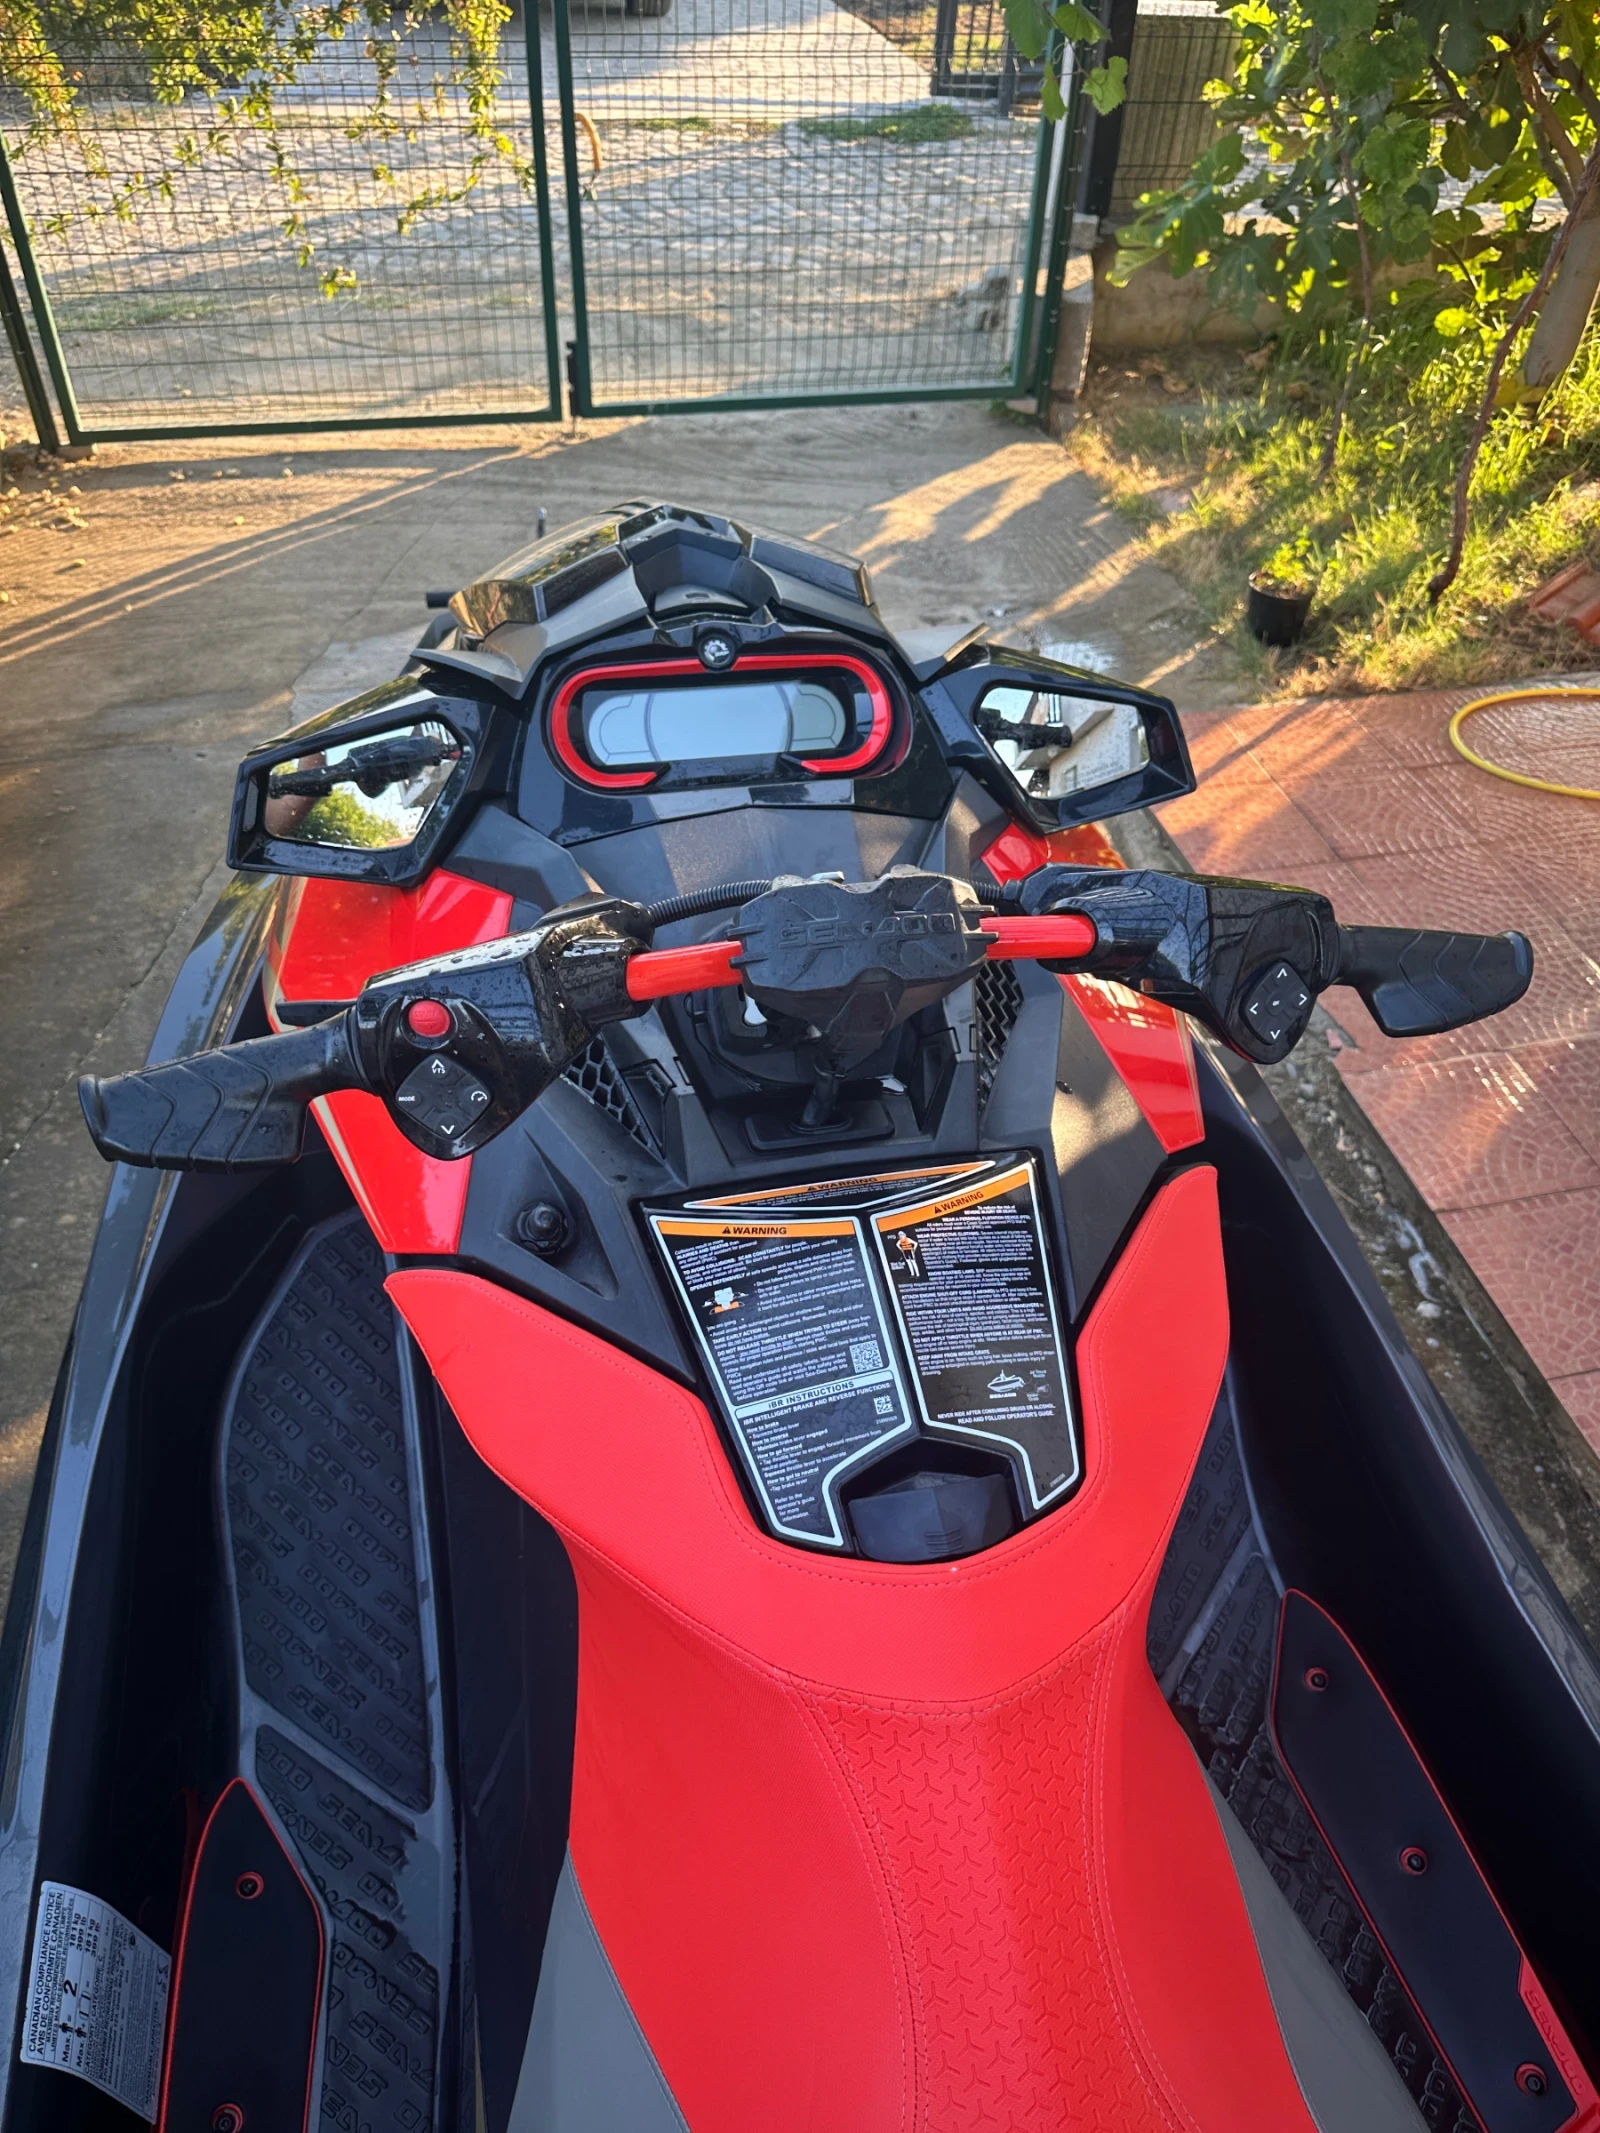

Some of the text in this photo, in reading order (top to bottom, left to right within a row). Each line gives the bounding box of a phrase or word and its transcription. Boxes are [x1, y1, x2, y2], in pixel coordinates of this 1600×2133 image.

[819, 1177, 878, 1189] WARNING
[940, 1192, 984, 1211] WARNING
[733, 1226, 787, 1236] WARNING
[761, 1336, 787, 1345] THROTTLE
[786, 1382, 854, 1404] INSTRUCTIONS
[754, 1408, 792, 1422] INTELLIGENT
[793, 1402, 814, 1412] BRAKE
[814, 1398, 827, 1406] AND
[828, 1391, 856, 1402] REVERSE
[51, 1893, 63, 1943] CANADIEN
[88, 1919, 96, 1931] kg
[69, 1913, 81, 1948] 181 kg
[77, 1916, 87, 1951] 399 lb
[29, 1892, 55, 2052] CANADIAN COMPLIANCE NOTICE
[64, 1979, 78, 1997] 2
[40, 2013, 48, 2028] DE
[36, 2030, 46, 2055] AVIS
[62, 2035, 71, 2062] Max.
